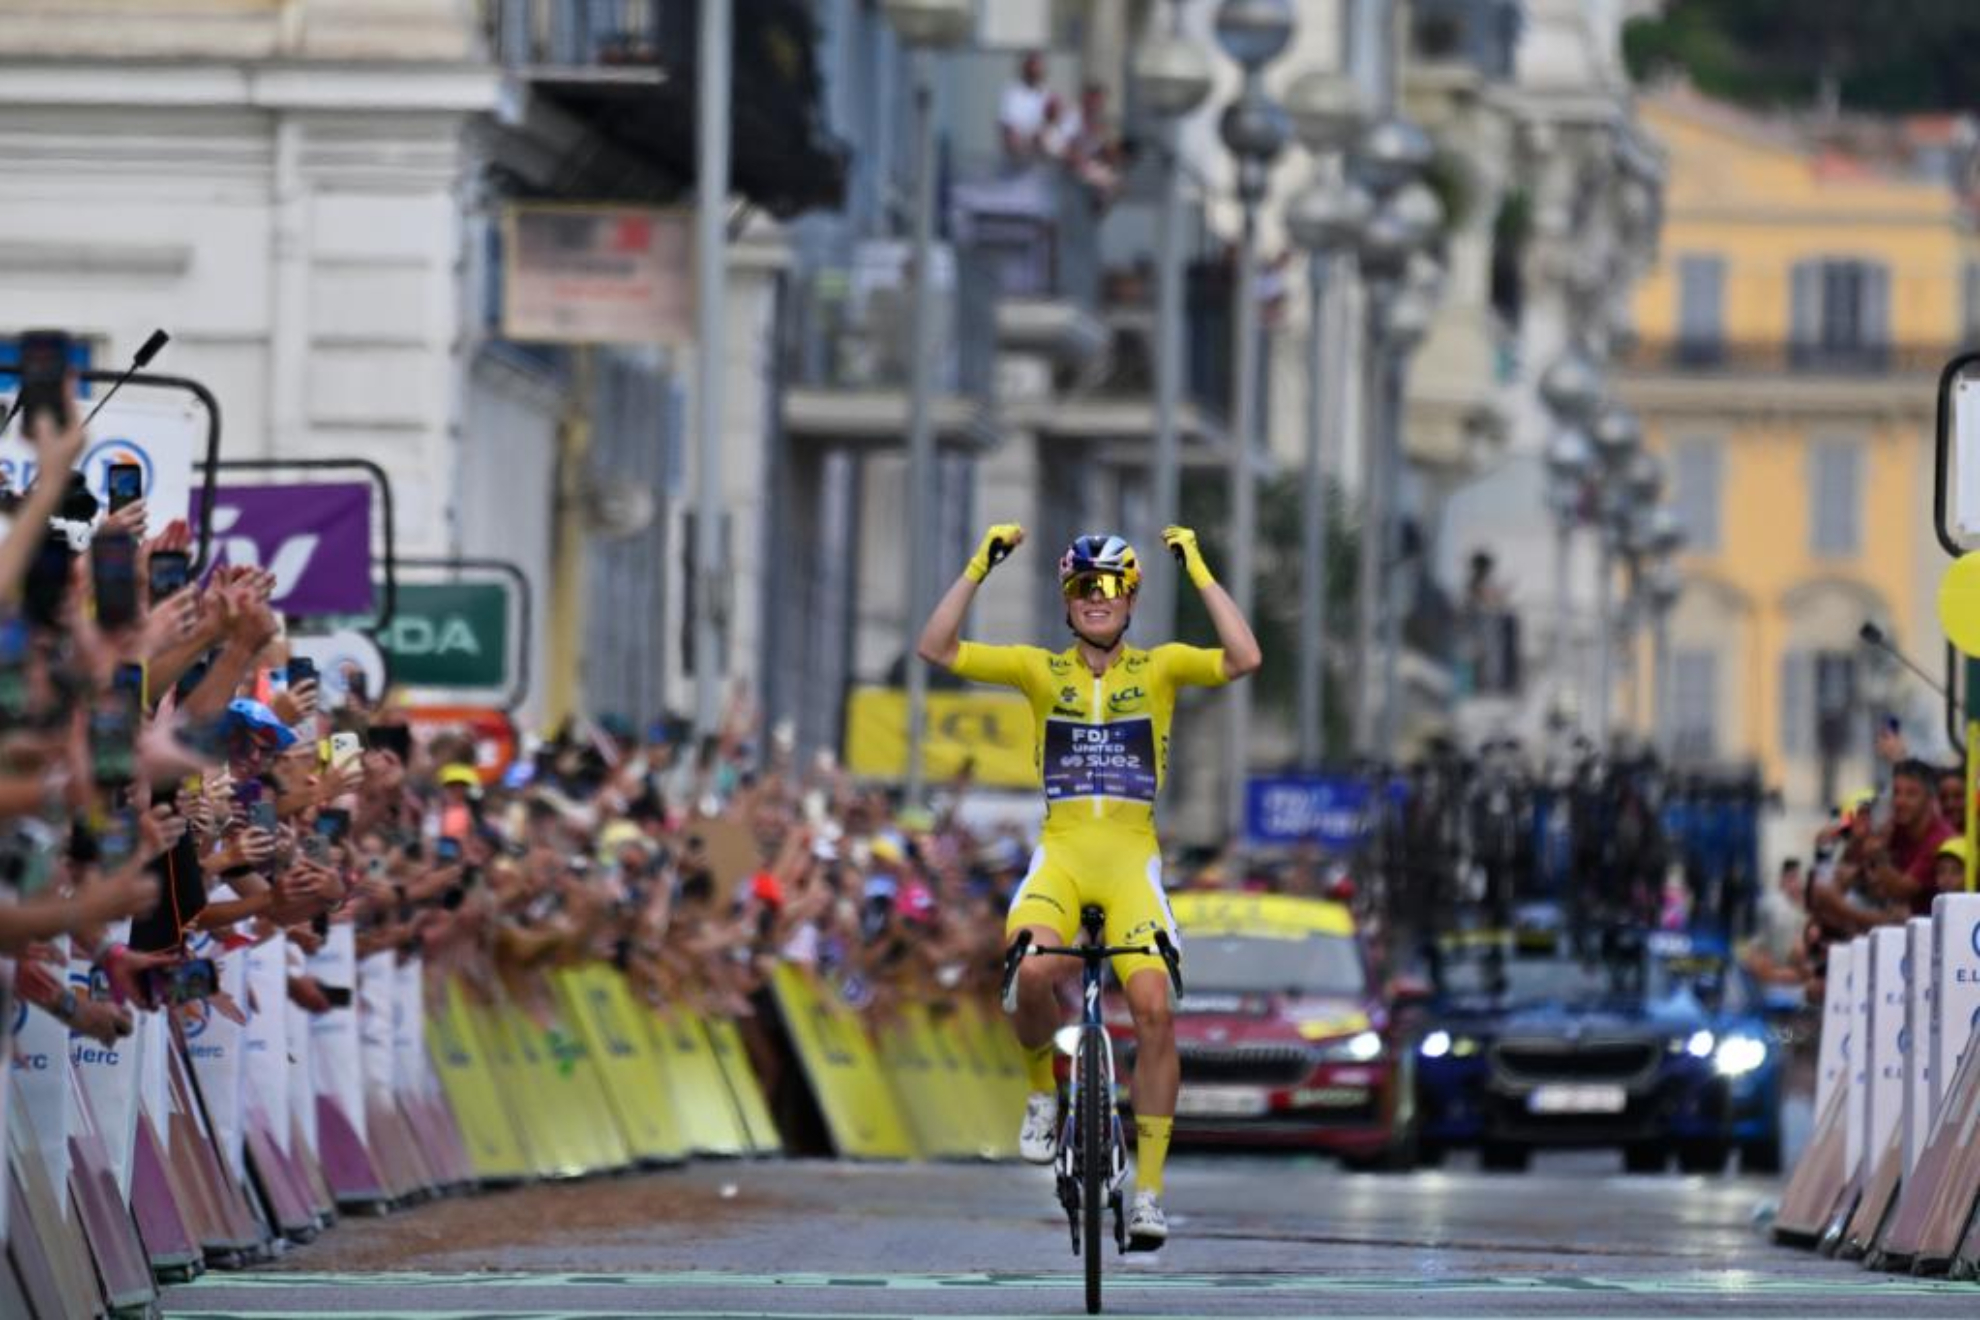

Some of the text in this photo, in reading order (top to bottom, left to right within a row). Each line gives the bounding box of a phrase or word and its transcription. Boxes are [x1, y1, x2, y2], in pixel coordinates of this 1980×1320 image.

[1111, 686, 1145, 704] LCL
[1071, 727, 1110, 745] FDJ
[1071, 743, 1126, 753] UNITED
